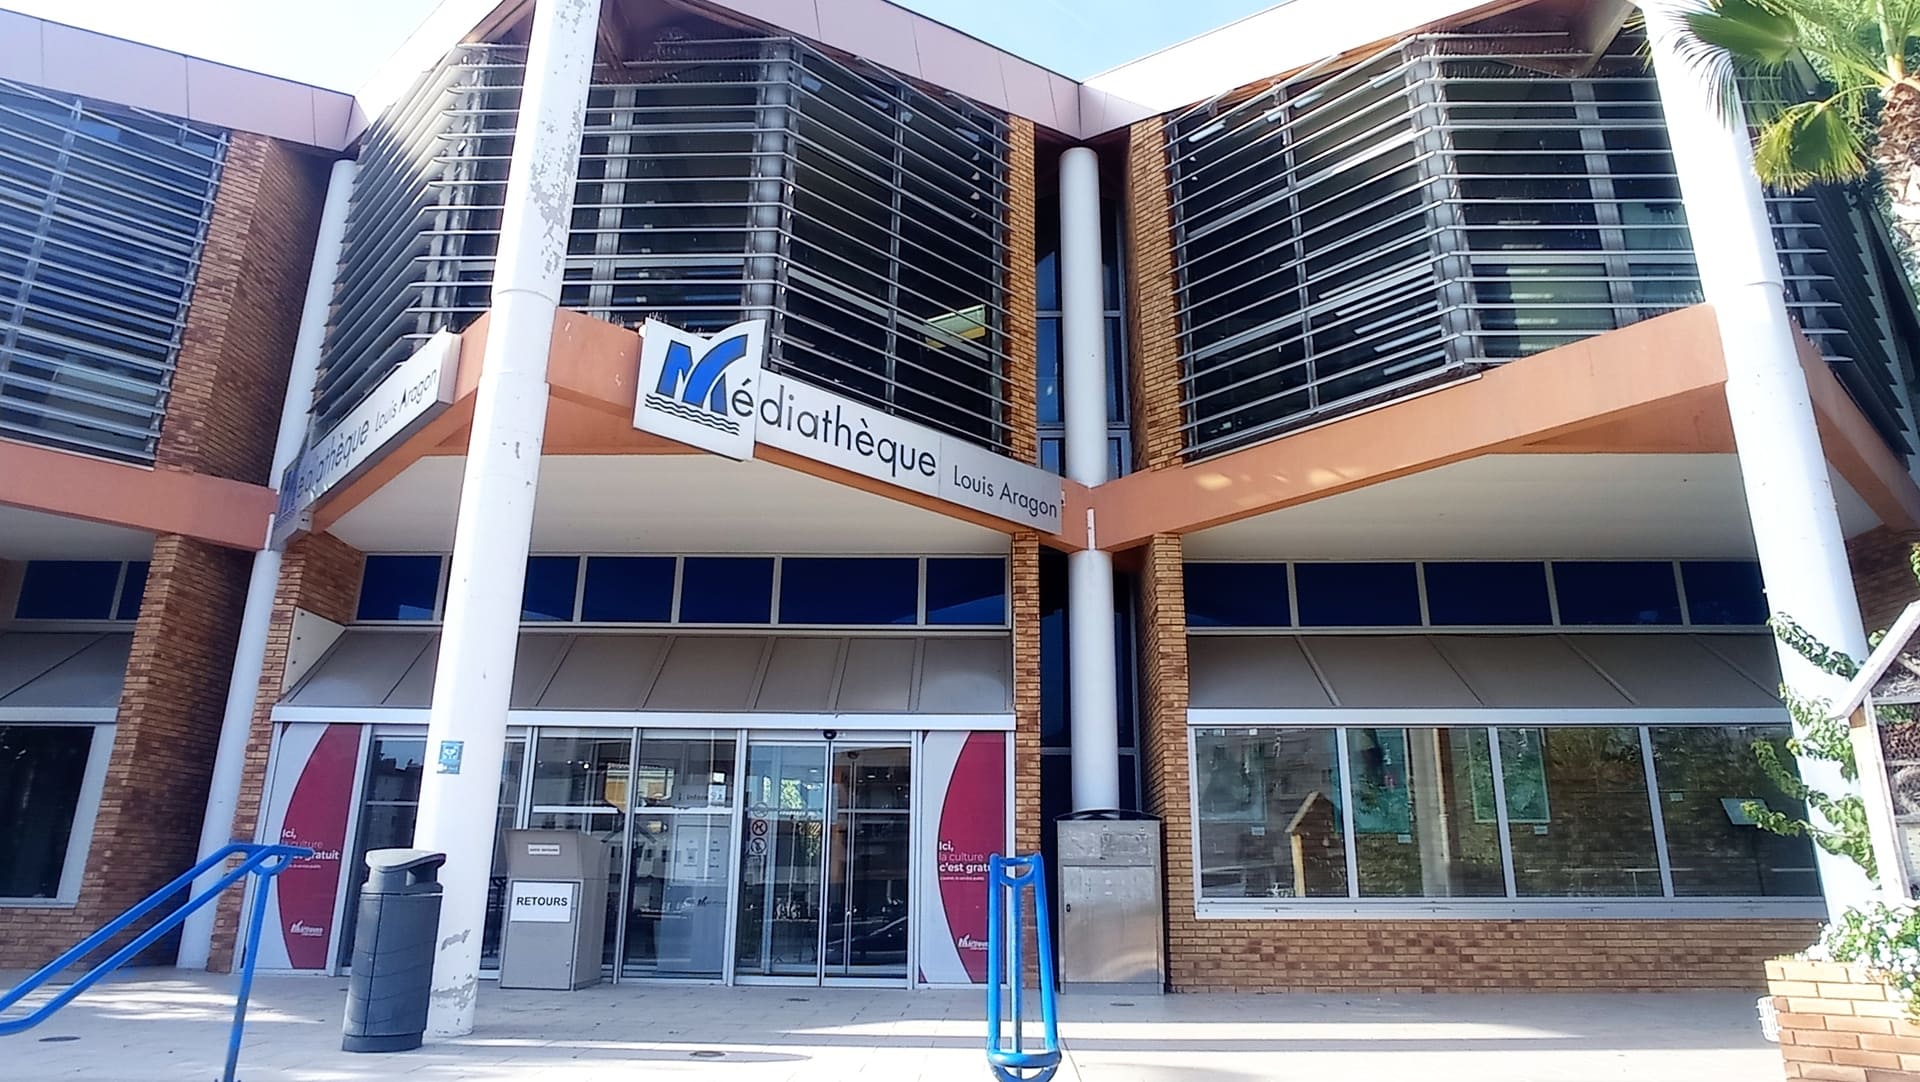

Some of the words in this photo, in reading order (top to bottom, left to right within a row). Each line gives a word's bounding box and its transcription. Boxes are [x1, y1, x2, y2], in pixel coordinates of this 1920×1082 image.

[399, 369, 437, 413] Aragon
[656, 333, 937, 478] Médiathèque
[954, 465, 994, 497] Louis
[1000, 482, 1058, 518] Aragon
[939, 841, 954, 852] Ici,
[939, 852, 947, 861] la
[949, 852, 984, 861] culture
[939, 863, 963, 872] c'est
[966, 864, 990, 873] grat
[516, 896, 568, 906] RETOURS
